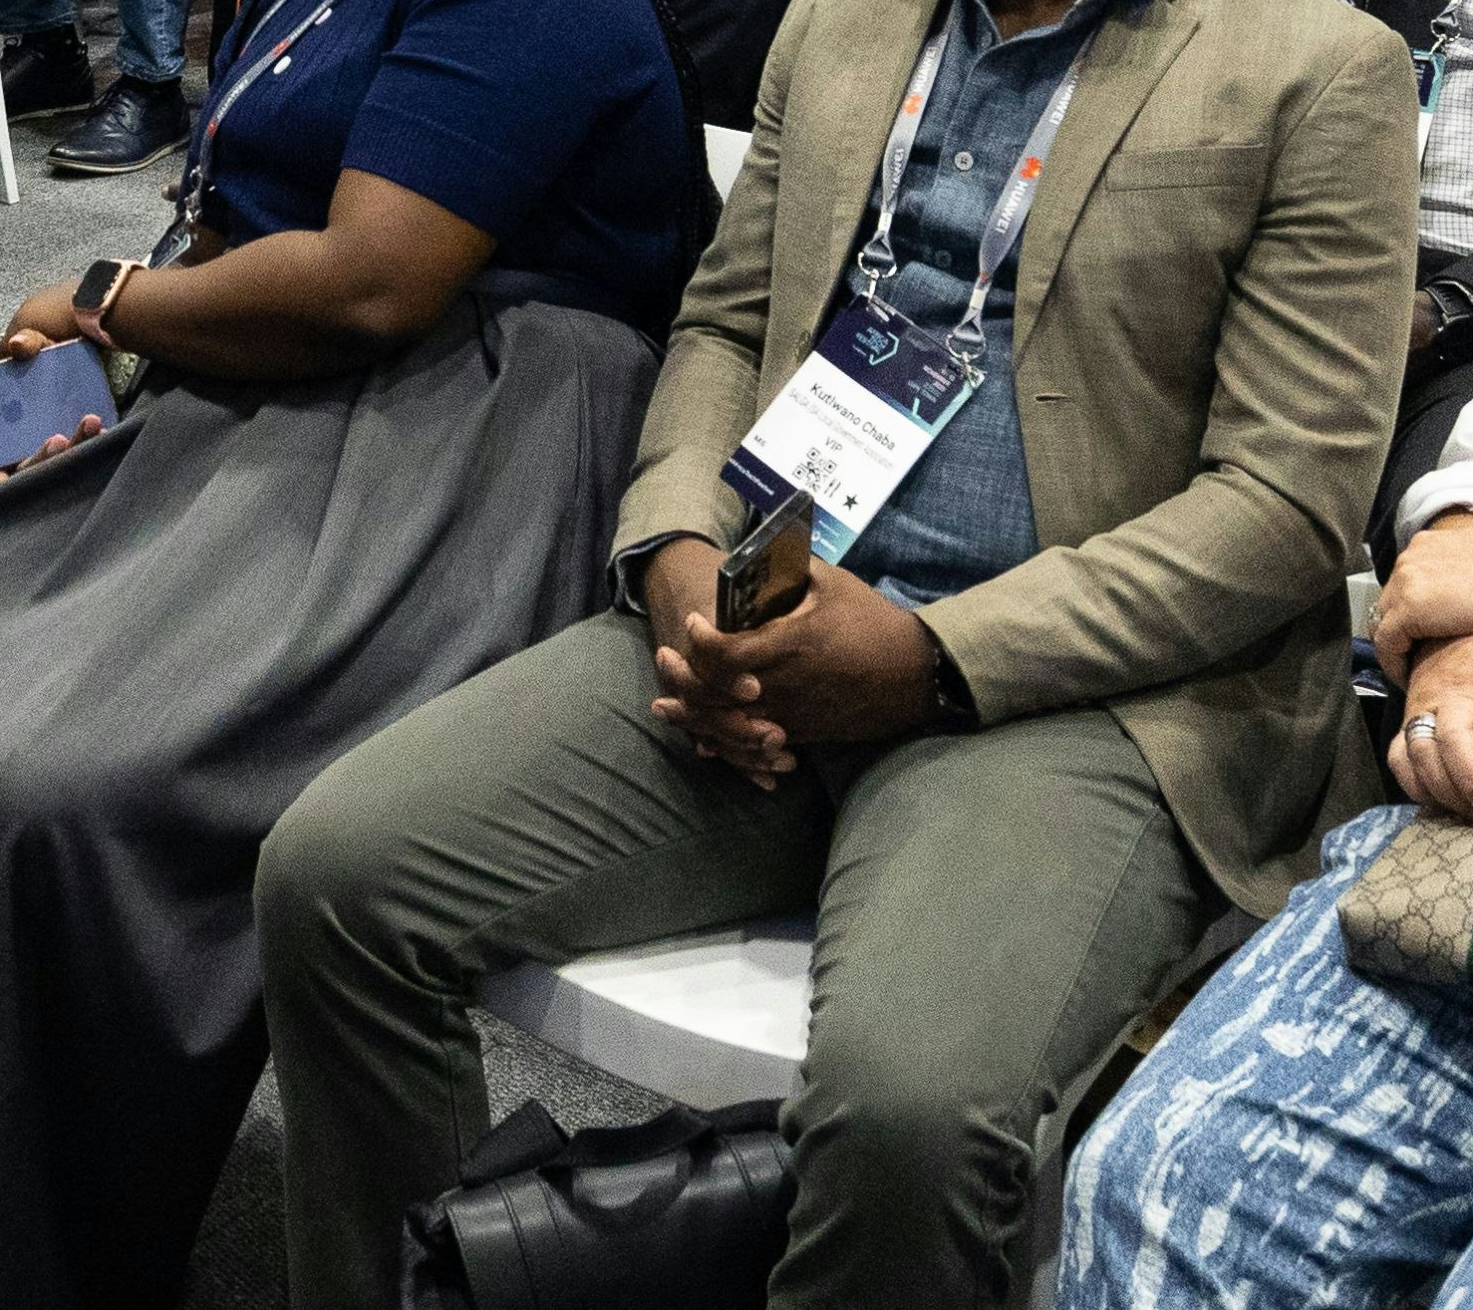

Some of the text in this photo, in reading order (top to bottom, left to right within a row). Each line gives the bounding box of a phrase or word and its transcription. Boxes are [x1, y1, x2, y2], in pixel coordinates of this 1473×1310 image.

[996, 180, 1029, 234] HUAWEI
[823, 437, 843, 455] VIP
[860, 420, 898, 452] Chaba
